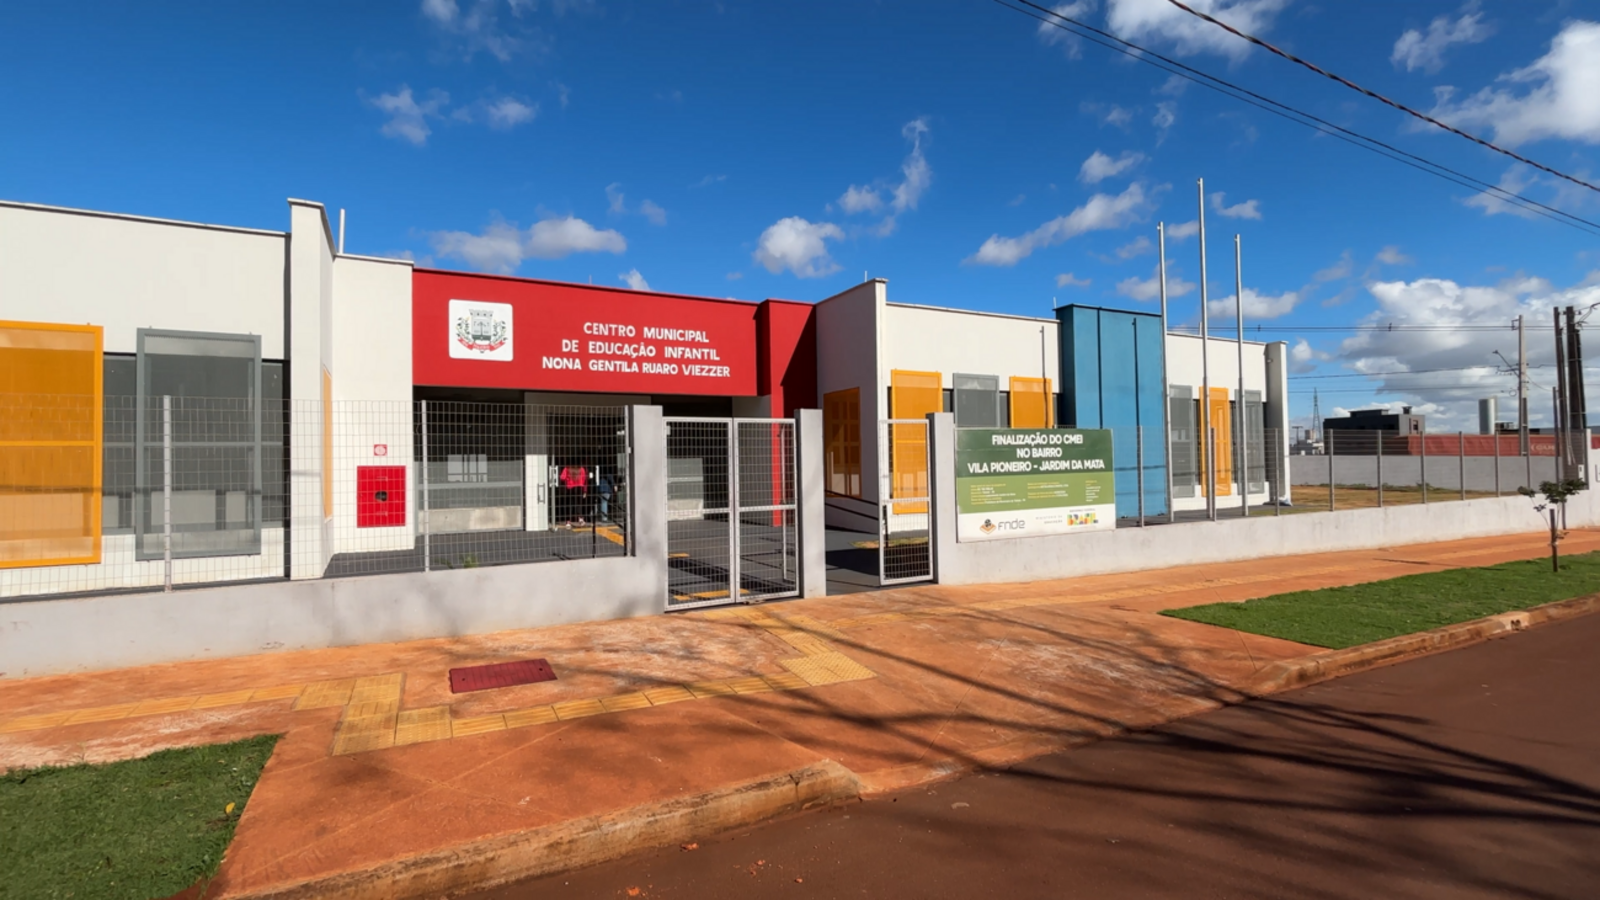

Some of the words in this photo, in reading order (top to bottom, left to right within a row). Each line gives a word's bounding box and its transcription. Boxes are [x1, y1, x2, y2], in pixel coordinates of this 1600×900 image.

[583, 322, 636, 338] CENTRO
[643, 326, 710, 343] MUNICIPAL
[562, 339, 579, 353] DE
[588, 341, 656, 358] EDUCAÇÃO
[664, 346, 720, 361] INFANTIL
[542, 356, 582, 370] NONA
[588, 359, 639, 373] GENTILA
[642, 362, 678, 375] RUARO
[682, 364, 731, 377] VIEZZER
[992, 432, 1048, 447] FINALIZAÇÃO
[1049, 434, 1062, 444] DO
[1063, 434, 1083, 444] CMEI
[1016, 448, 1031, 458] NO
[1032, 447, 1063, 458] BAIRRO
[967, 462, 989, 474] VILA
[991, 461, 1032, 473] PIONEIRO
[1039, 460, 1070, 471] JARDIM
[1071, 460, 1083, 470] DA
[1084, 459, 1105, 469] MATA
